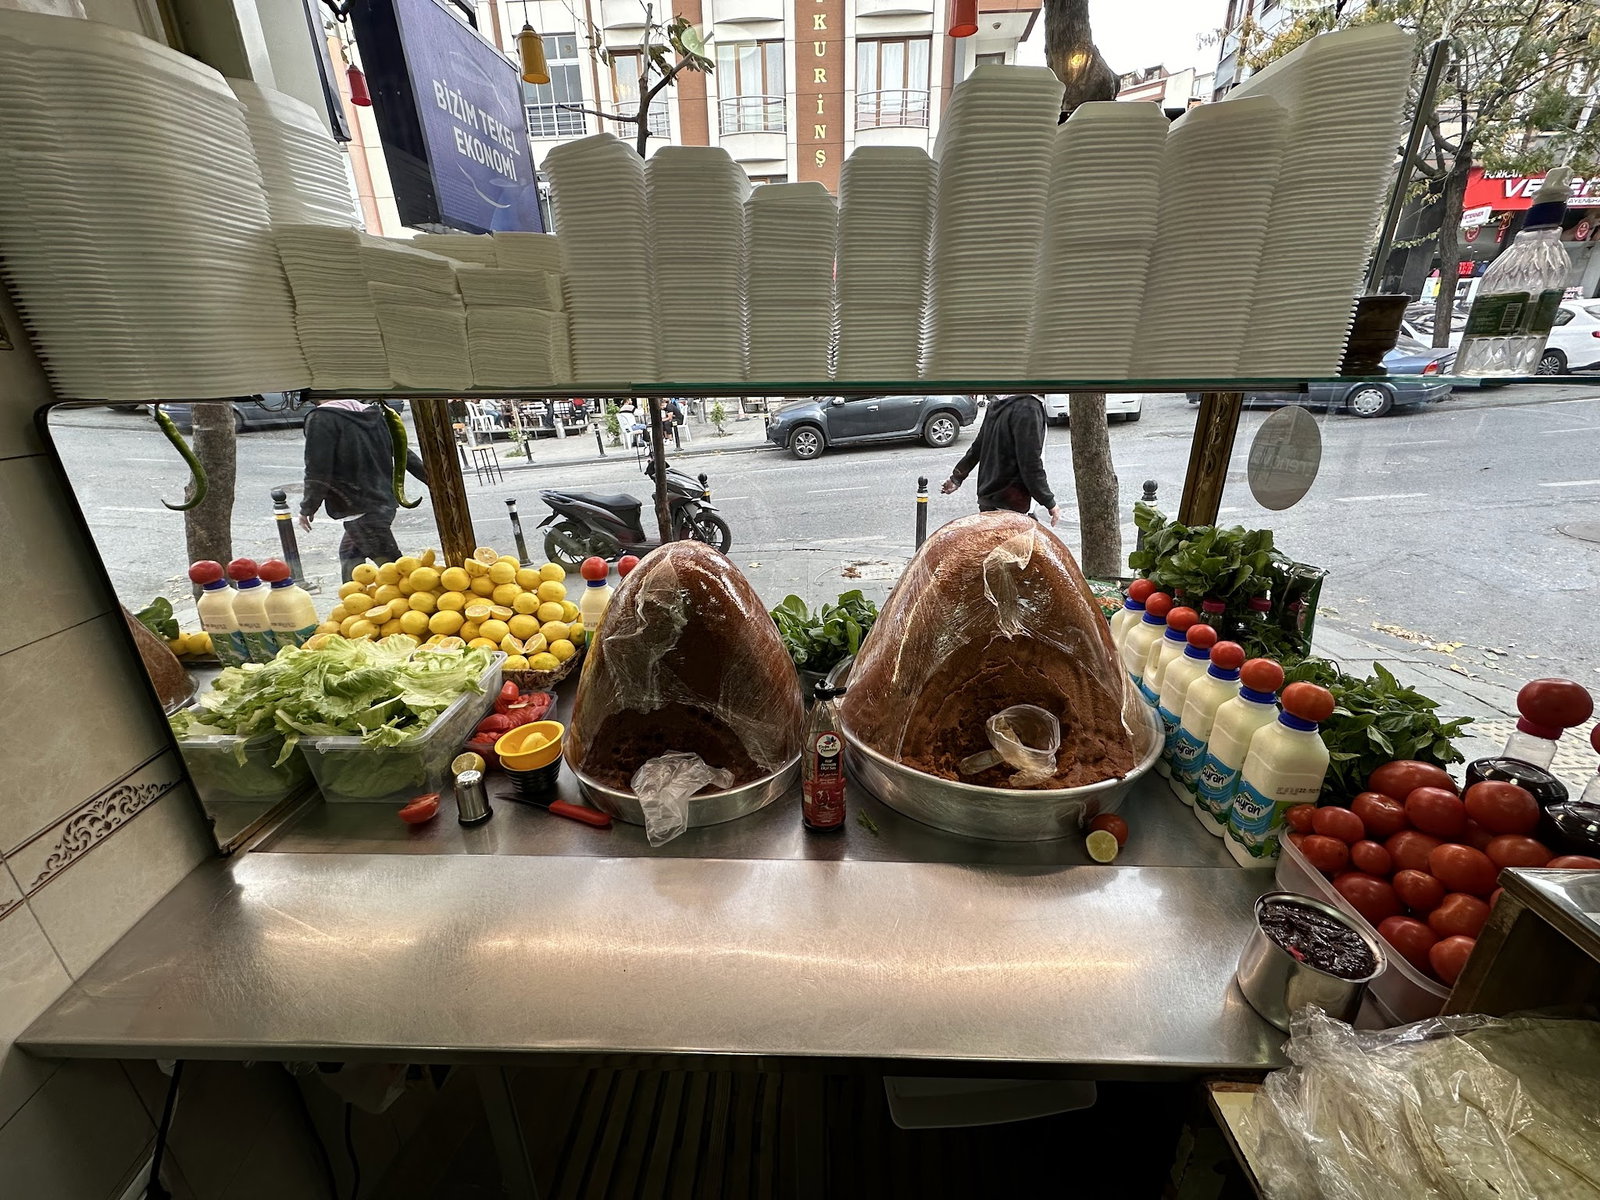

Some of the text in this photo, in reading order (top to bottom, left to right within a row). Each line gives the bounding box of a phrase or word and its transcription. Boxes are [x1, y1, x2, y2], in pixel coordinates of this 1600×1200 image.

[432, 79, 521, 156] BİZİM TEKEL
[453, 125, 518, 182] EKONOMİ
[1202, 766, 1226, 786] Ayran
[1234, 794, 1262, 817] Ayran
